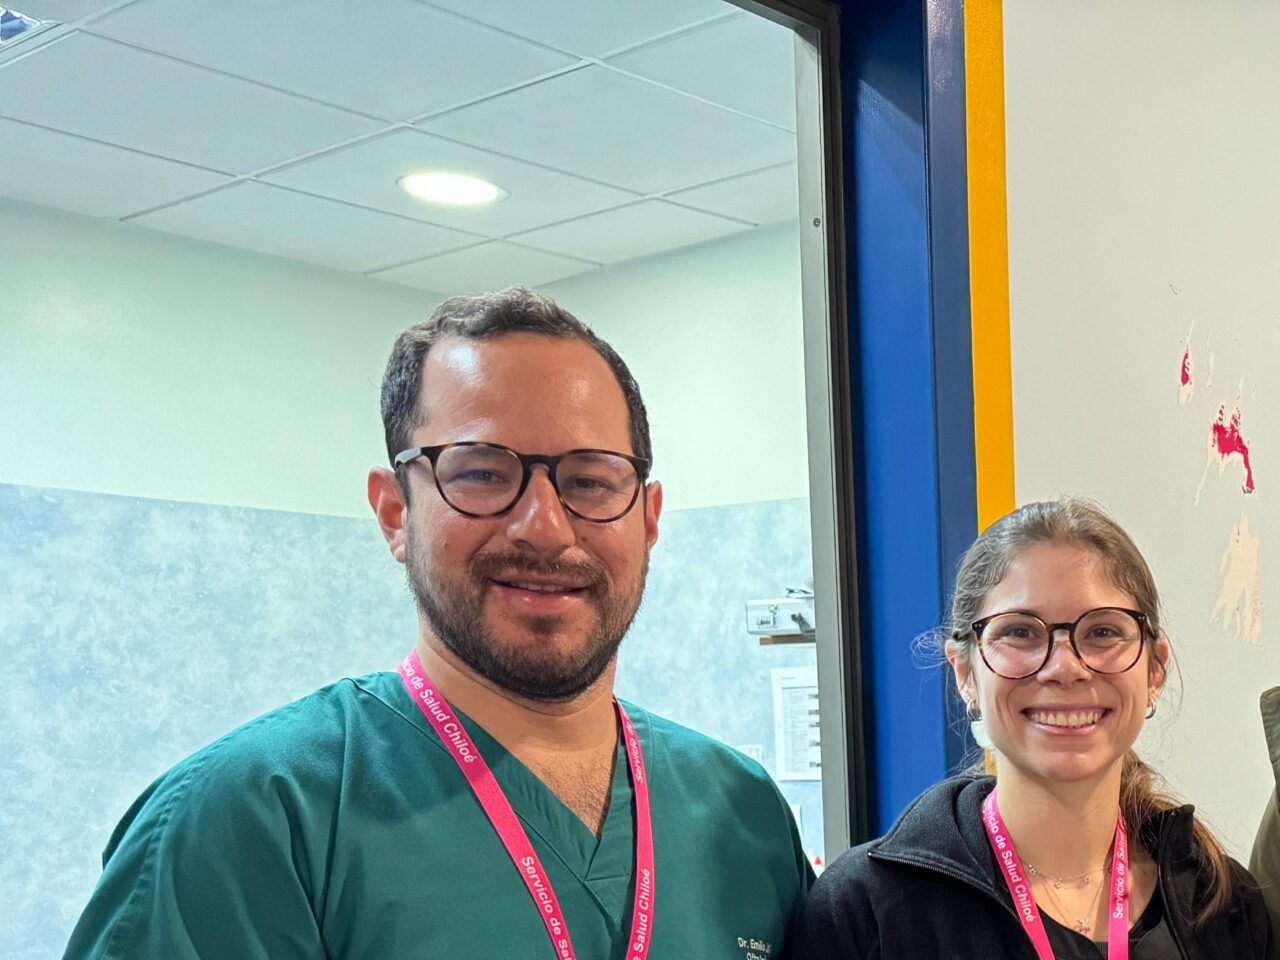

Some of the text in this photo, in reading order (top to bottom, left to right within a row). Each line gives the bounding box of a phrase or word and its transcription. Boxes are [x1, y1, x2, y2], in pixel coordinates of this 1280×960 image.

[420, 689, 451, 722] Salud
[443, 723, 477, 763] Chiloé
[521, 856, 554, 914] Servicio
[550, 917, 562, 935] de
[638, 868, 651, 911] Chiloé
[995, 834, 1006, 849] de
[1002, 850, 1022, 883] Salud
[1015, 884, 1037, 922] Chiloé
[1113, 877, 1125, 919] Servicio
[633, 913, 648, 953] Salud
[737, 937, 750, 949] Dr.
